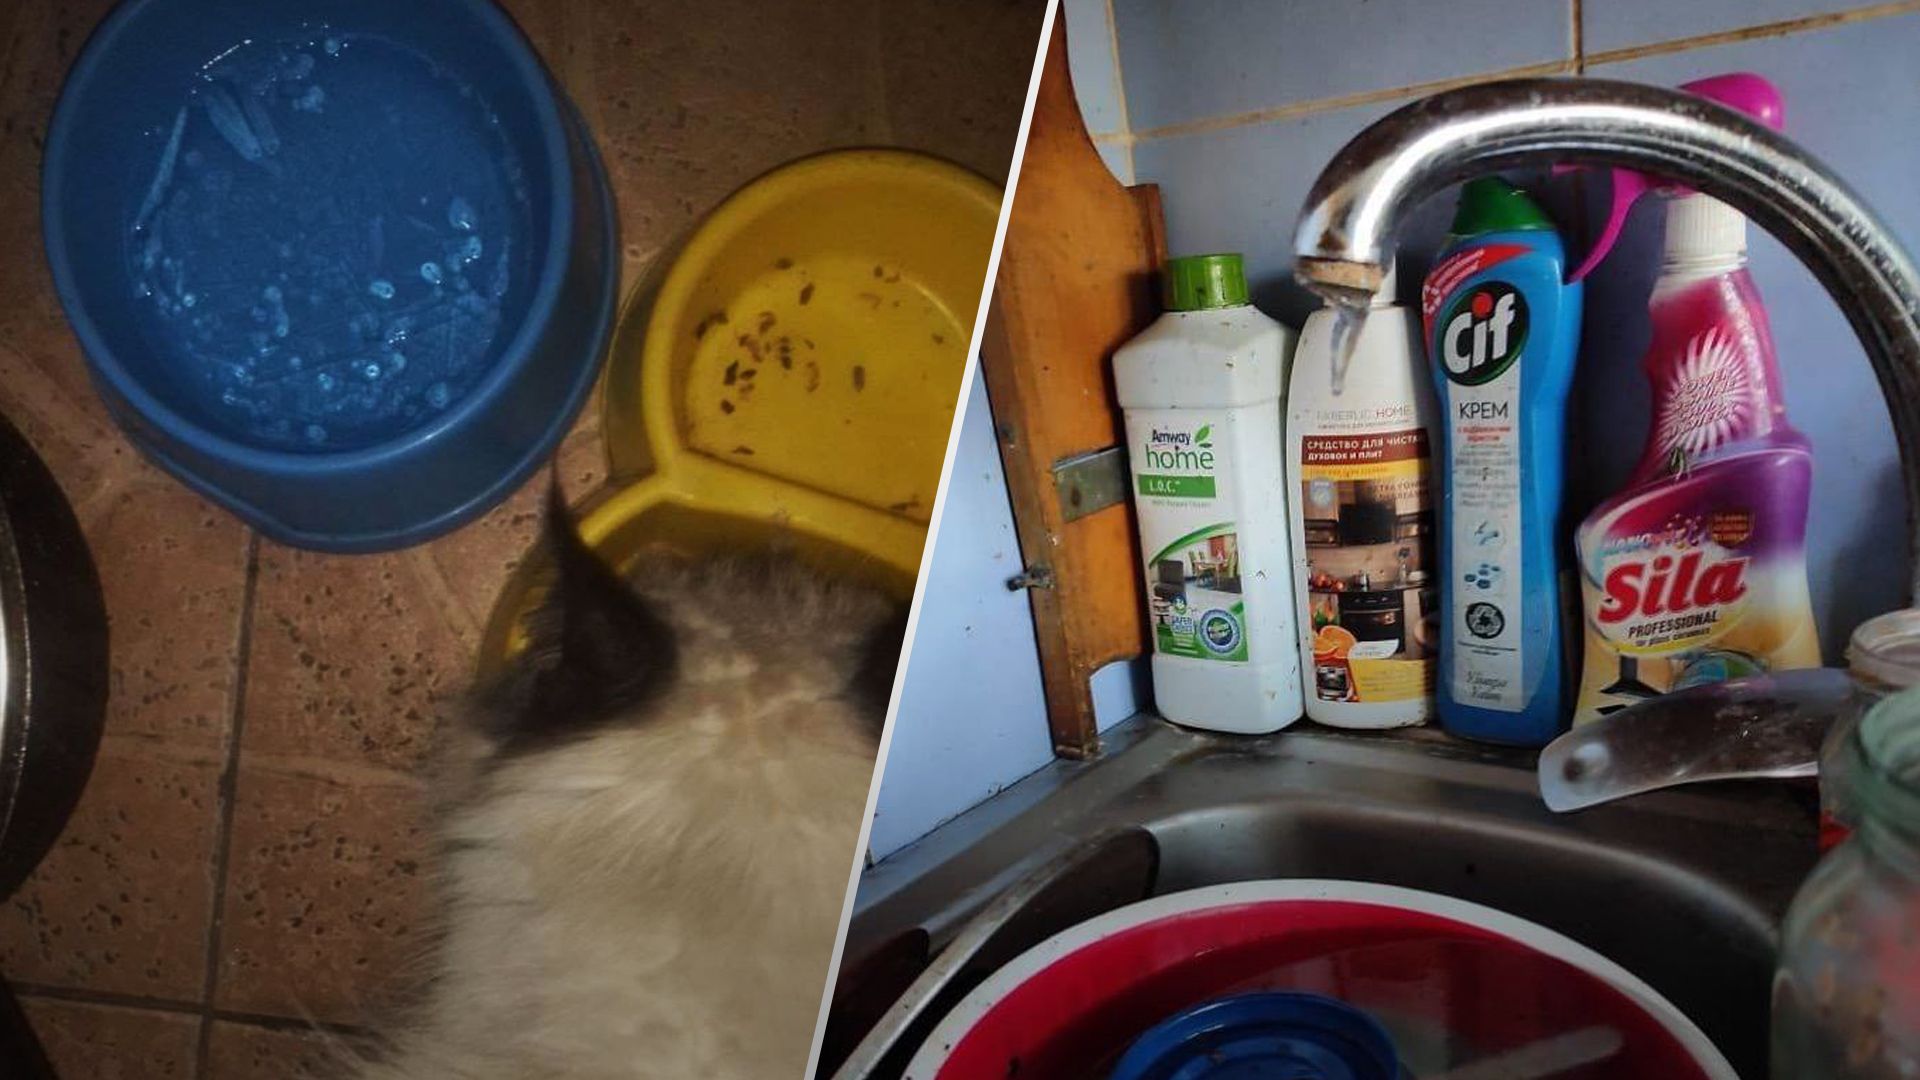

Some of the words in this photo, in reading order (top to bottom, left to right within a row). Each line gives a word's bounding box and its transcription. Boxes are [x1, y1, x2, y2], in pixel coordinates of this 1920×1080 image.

[1443, 292, 1516, 374] Cif
[1459, 401, 1508, 419] КРЕМ
[1151, 429, 1191, 446] Amway
[1306, 439, 1359, 450] СРЕДСТВО
[1361, 437, 1383, 449] ДЛЯ
[1145, 443, 1214, 470] home
[1308, 451, 1347, 461] ДУХОВОК
[1597, 551, 1748, 625] Sila
[1628, 610, 1720, 639] PROFESSIONAL
